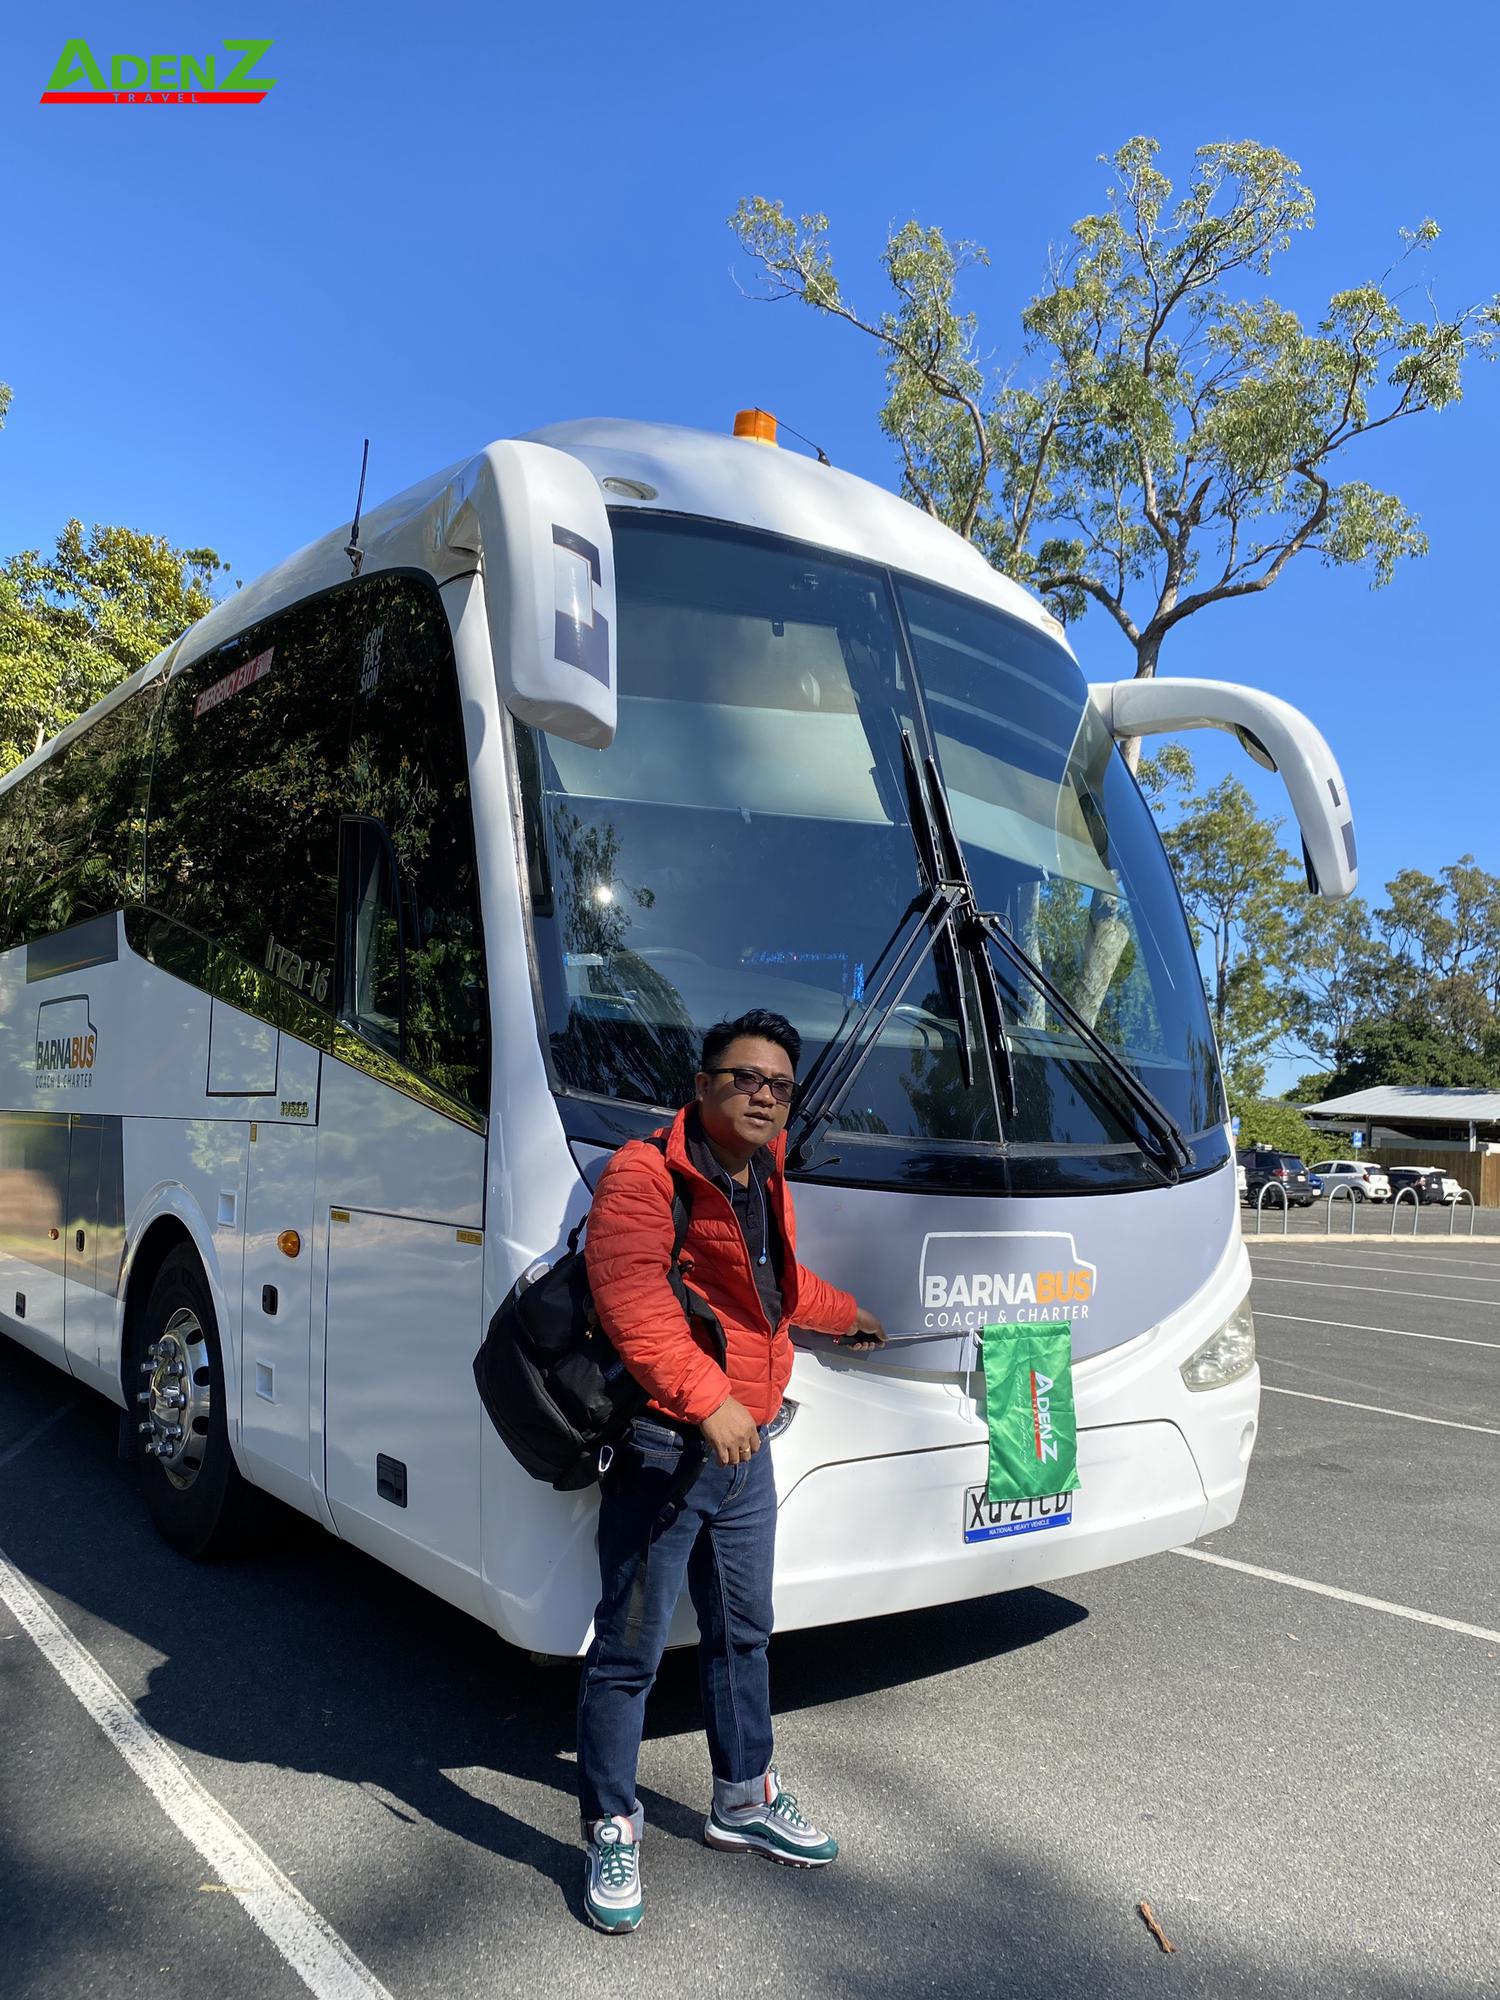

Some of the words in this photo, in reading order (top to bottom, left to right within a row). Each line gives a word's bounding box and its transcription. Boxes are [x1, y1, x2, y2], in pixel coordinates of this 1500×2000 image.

[36, 1034, 95, 1070] BARNABUS
[35, 1074, 54, 1089] COACH
[64, 1072, 93, 1088] CHARTER
[924, 1270, 1092, 1308] BARNABUS
[924, 1310, 989, 1328] COACH
[997, 1309, 1008, 1324] &
[1016, 1305, 1090, 1323] CHARTER
[1033, 1371, 1059, 1465] ADENZ
[988, 1526, 1013, 1536] NATIONAL
[1013, 1522, 1030, 1532] HEAVY
[1030, 1518, 1050, 1528] VEHICLE
